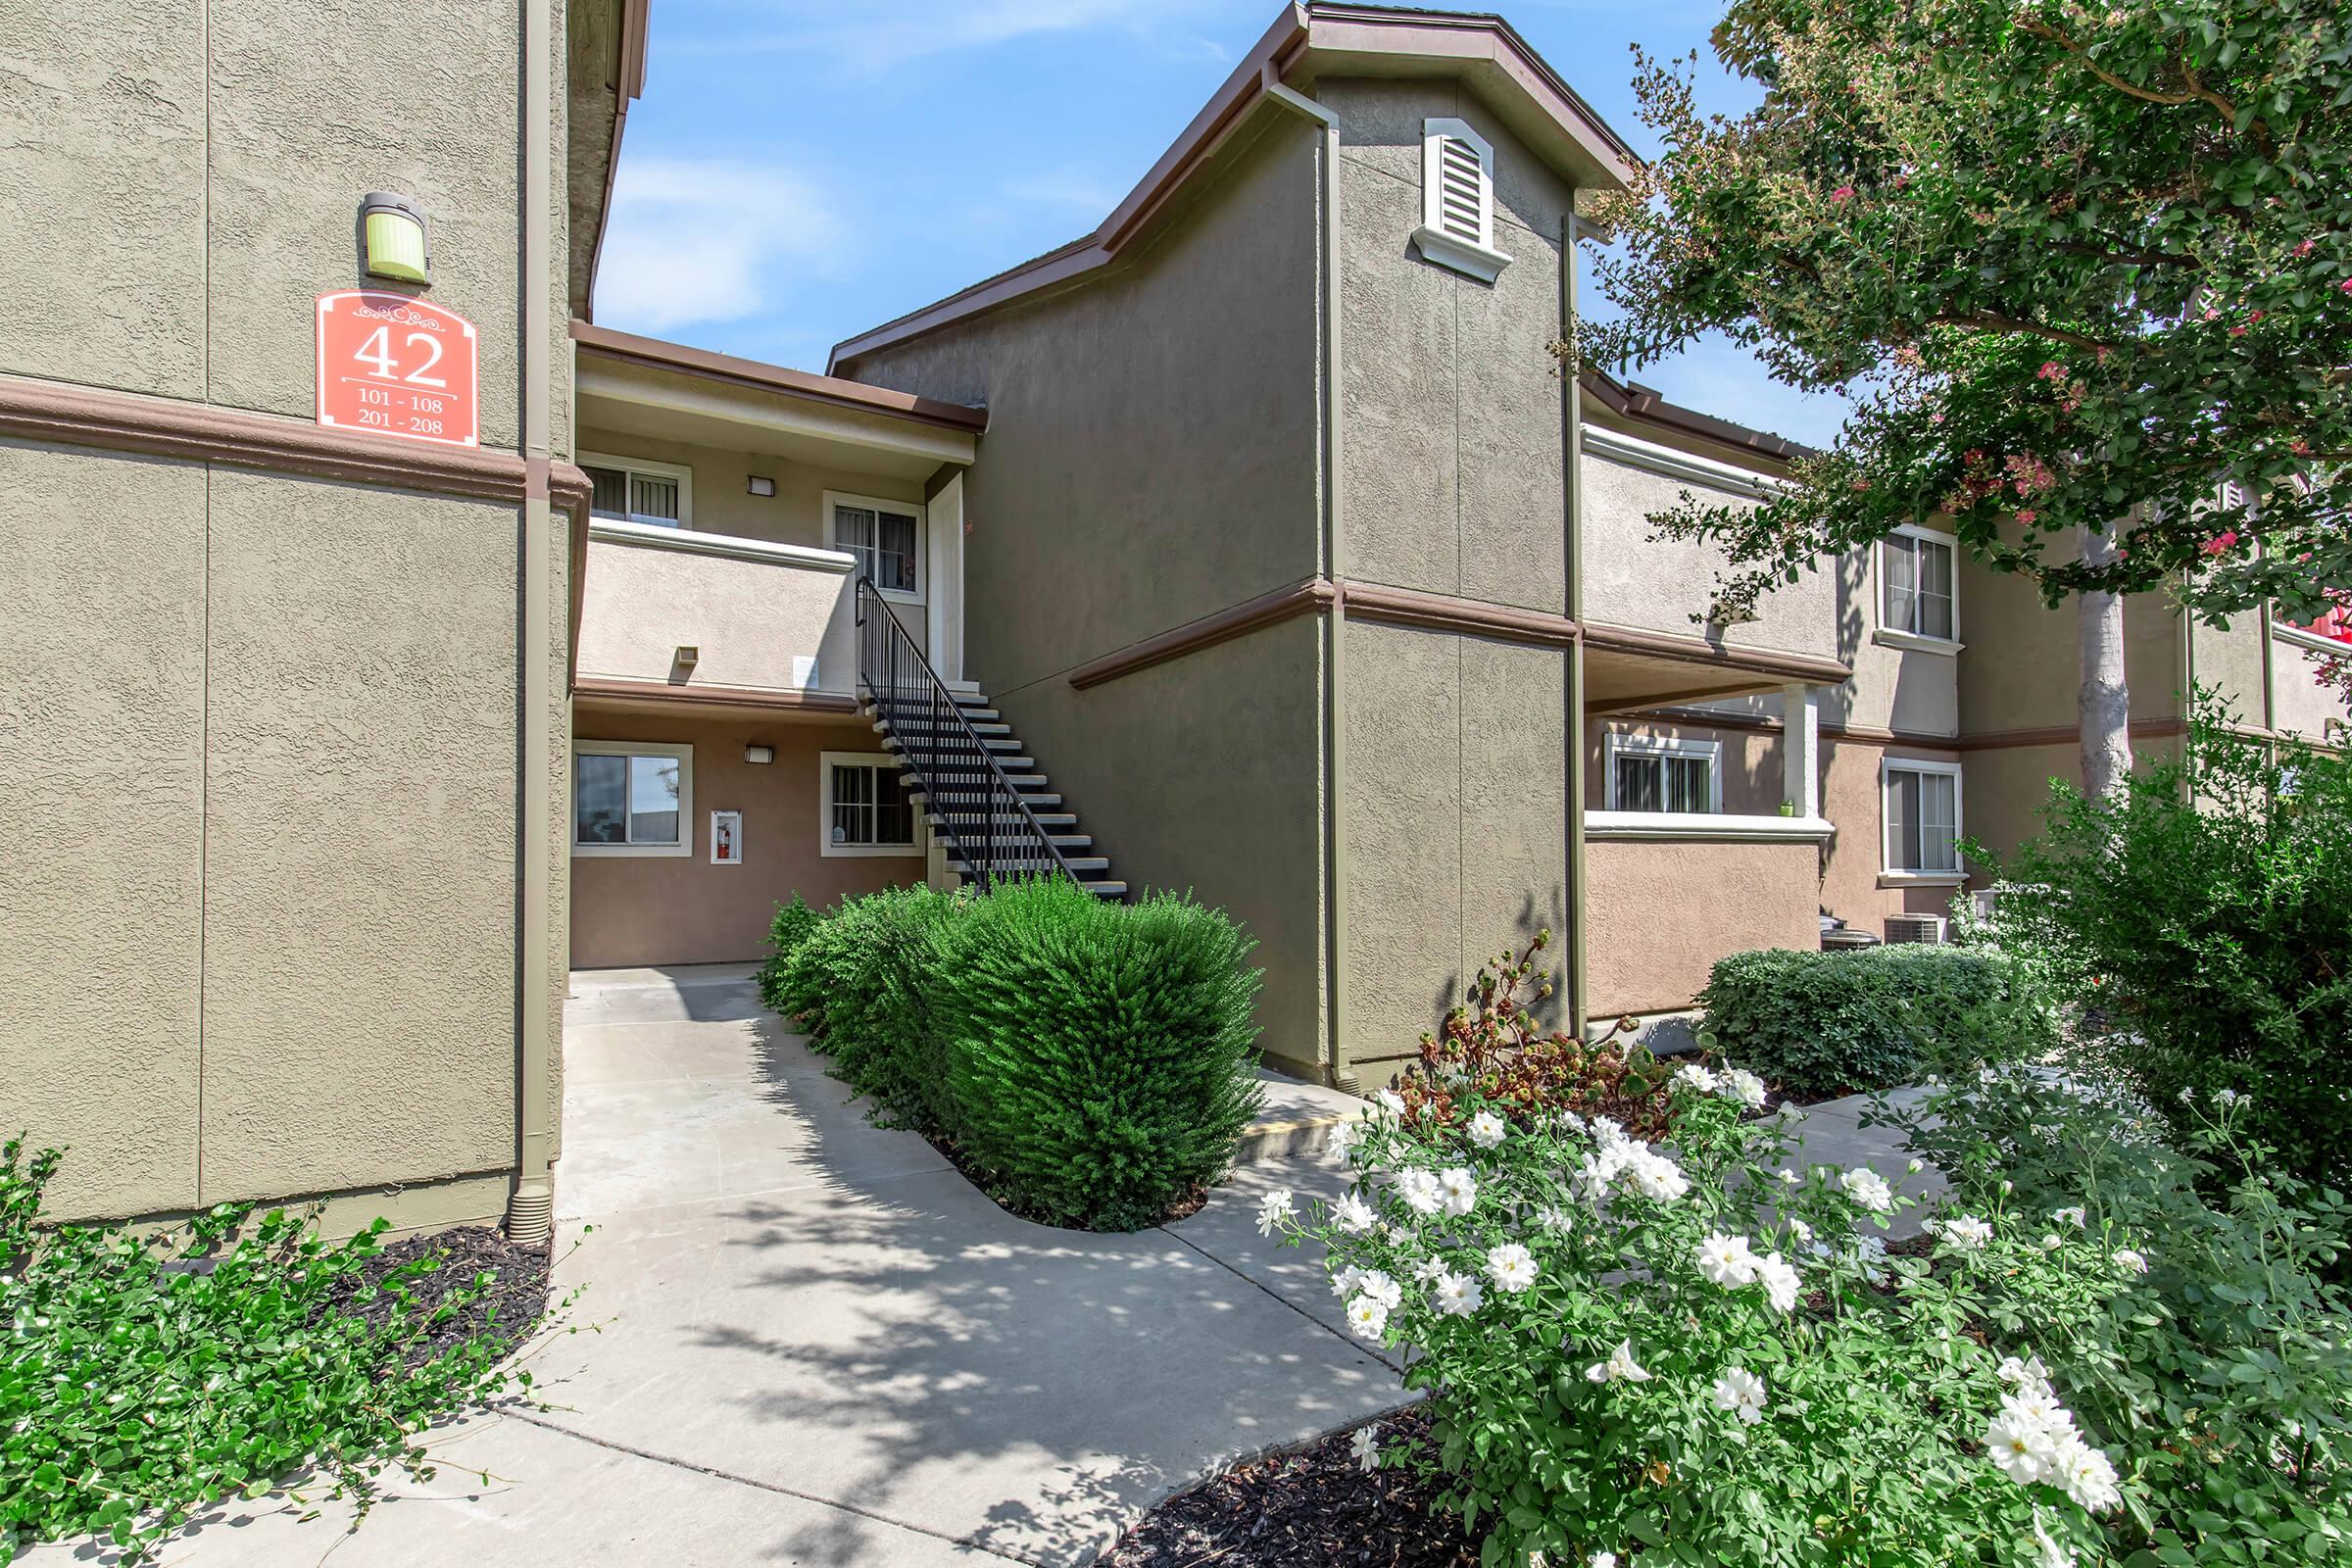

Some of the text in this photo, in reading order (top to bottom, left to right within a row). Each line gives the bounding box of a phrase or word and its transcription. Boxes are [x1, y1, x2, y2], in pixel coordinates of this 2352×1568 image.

[393, 308, 406, 319] C
[354, 325, 447, 388] 42
[358, 388, 391, 407] 101
[411, 396, 444, 415] 108
[358, 409, 392, 428] 201
[410, 416, 444, 435] 208
